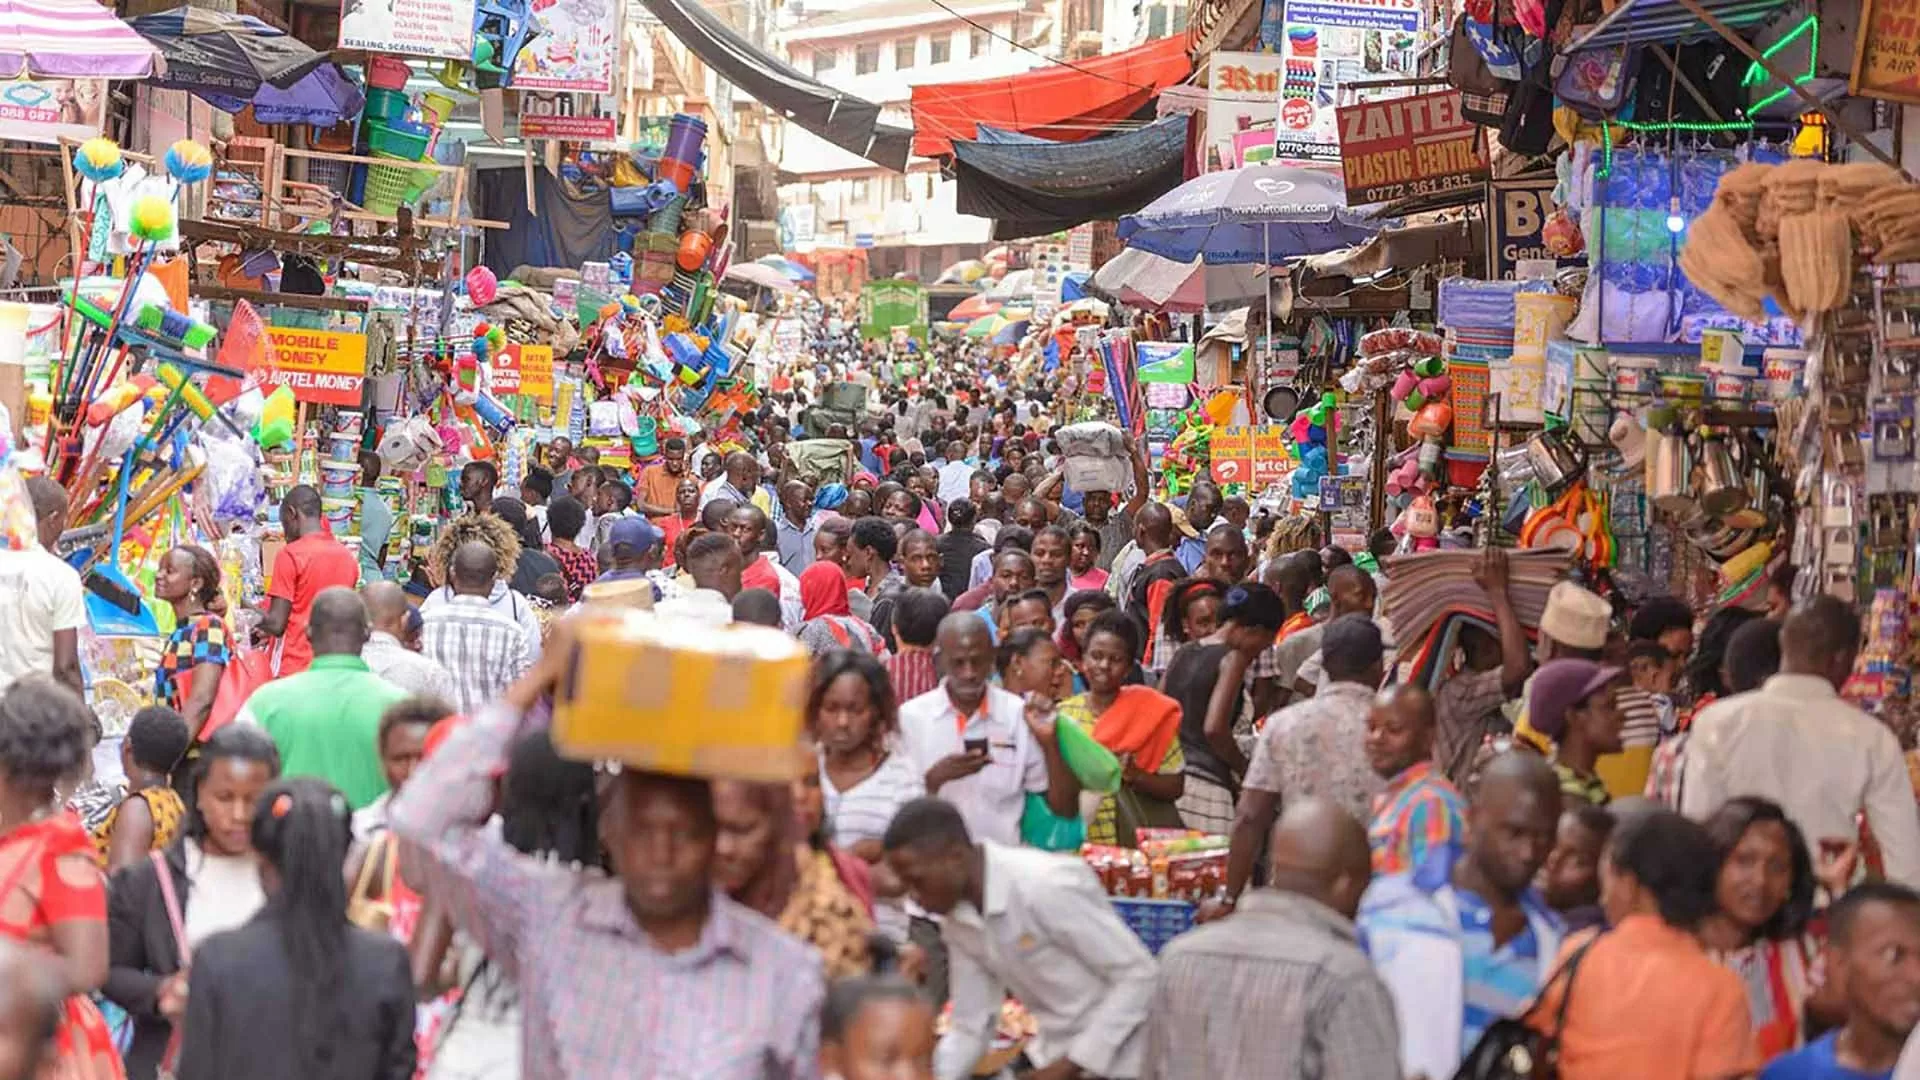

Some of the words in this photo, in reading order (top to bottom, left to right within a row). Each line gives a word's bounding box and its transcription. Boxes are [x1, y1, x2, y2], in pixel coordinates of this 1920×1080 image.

[388, 42, 435, 54] SCANNING
[1344, 147, 1412, 189] PLASTIC
[1367, 183, 1405, 202] 0772
[1442, 173, 1472, 189] 835
[269, 332, 340, 351] MOBILE
[269, 370, 314, 388] AIRTEL
[314, 374, 364, 391] MONEY
